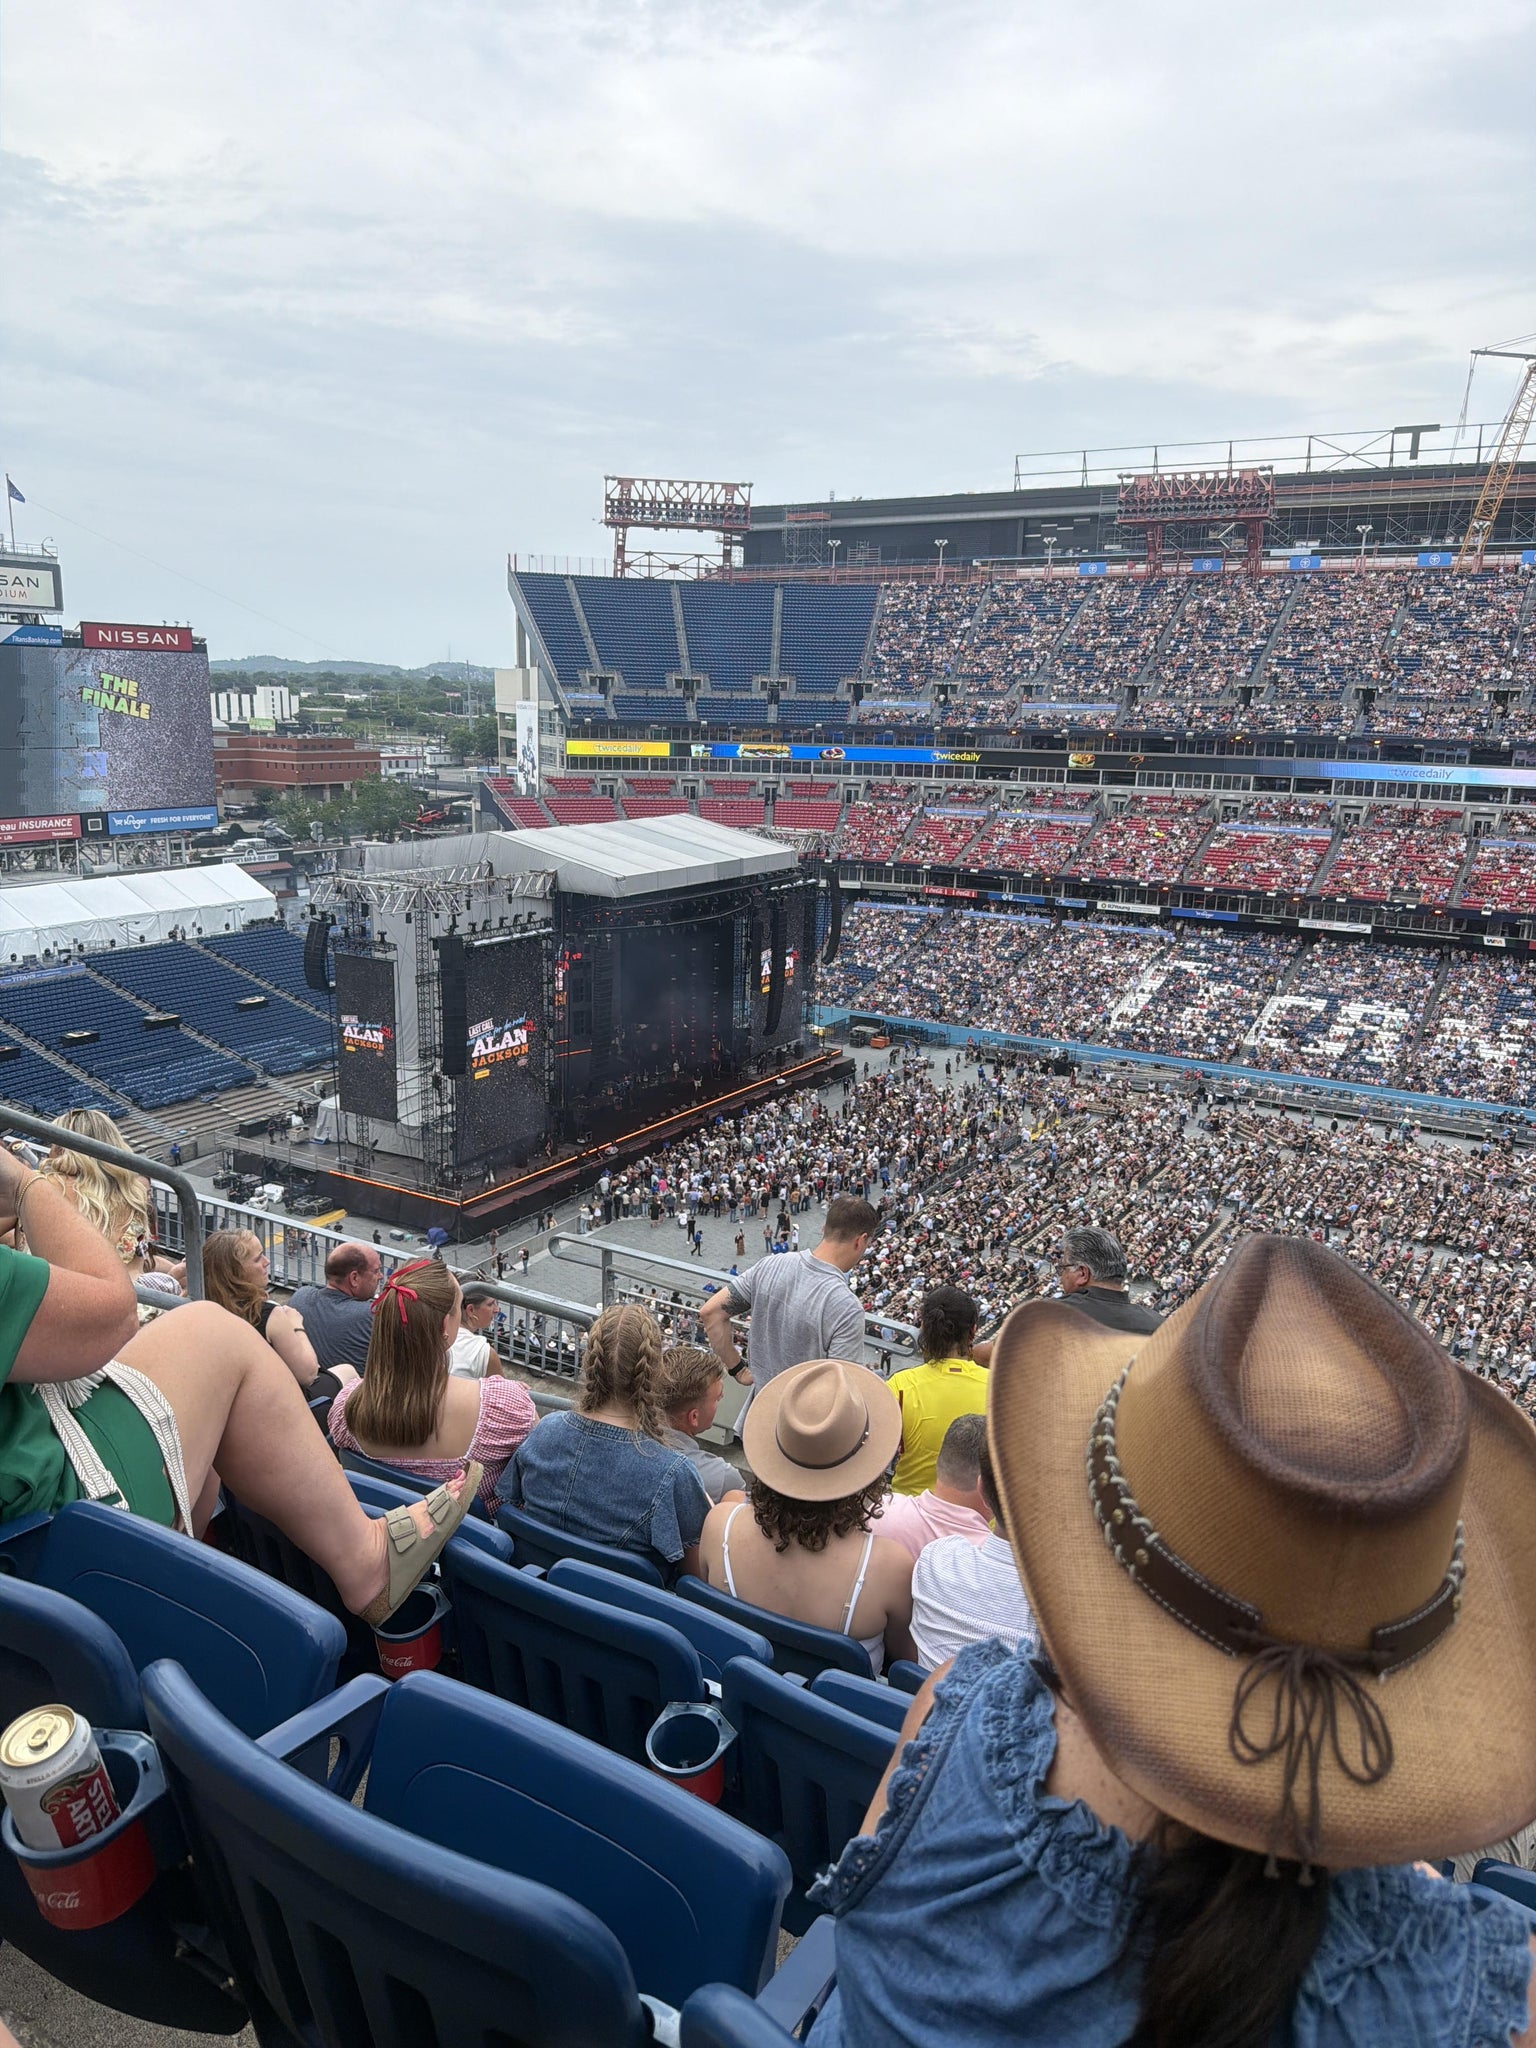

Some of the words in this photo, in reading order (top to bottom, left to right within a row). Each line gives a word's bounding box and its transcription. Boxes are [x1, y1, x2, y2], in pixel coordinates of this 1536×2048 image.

[11, 634, 62, 645] TitansBanking.com
[98, 629, 179, 646] NISSAN
[100, 671, 139, 698] THE
[81, 686, 152, 721] FINALE
[933, 751, 982, 762] twicedaily
[1391, 767, 1455, 780] twicedaily
[18, 818, 73, 830] INSURANCE
[123, 815, 147, 829] Kroger
[342, 1025, 384, 1044] ALAN
[343, 1037, 385, 1051] JACKSON
[471, 1028, 528, 1058] ALAN
[471, 1043, 529, 1068] JACKSON
